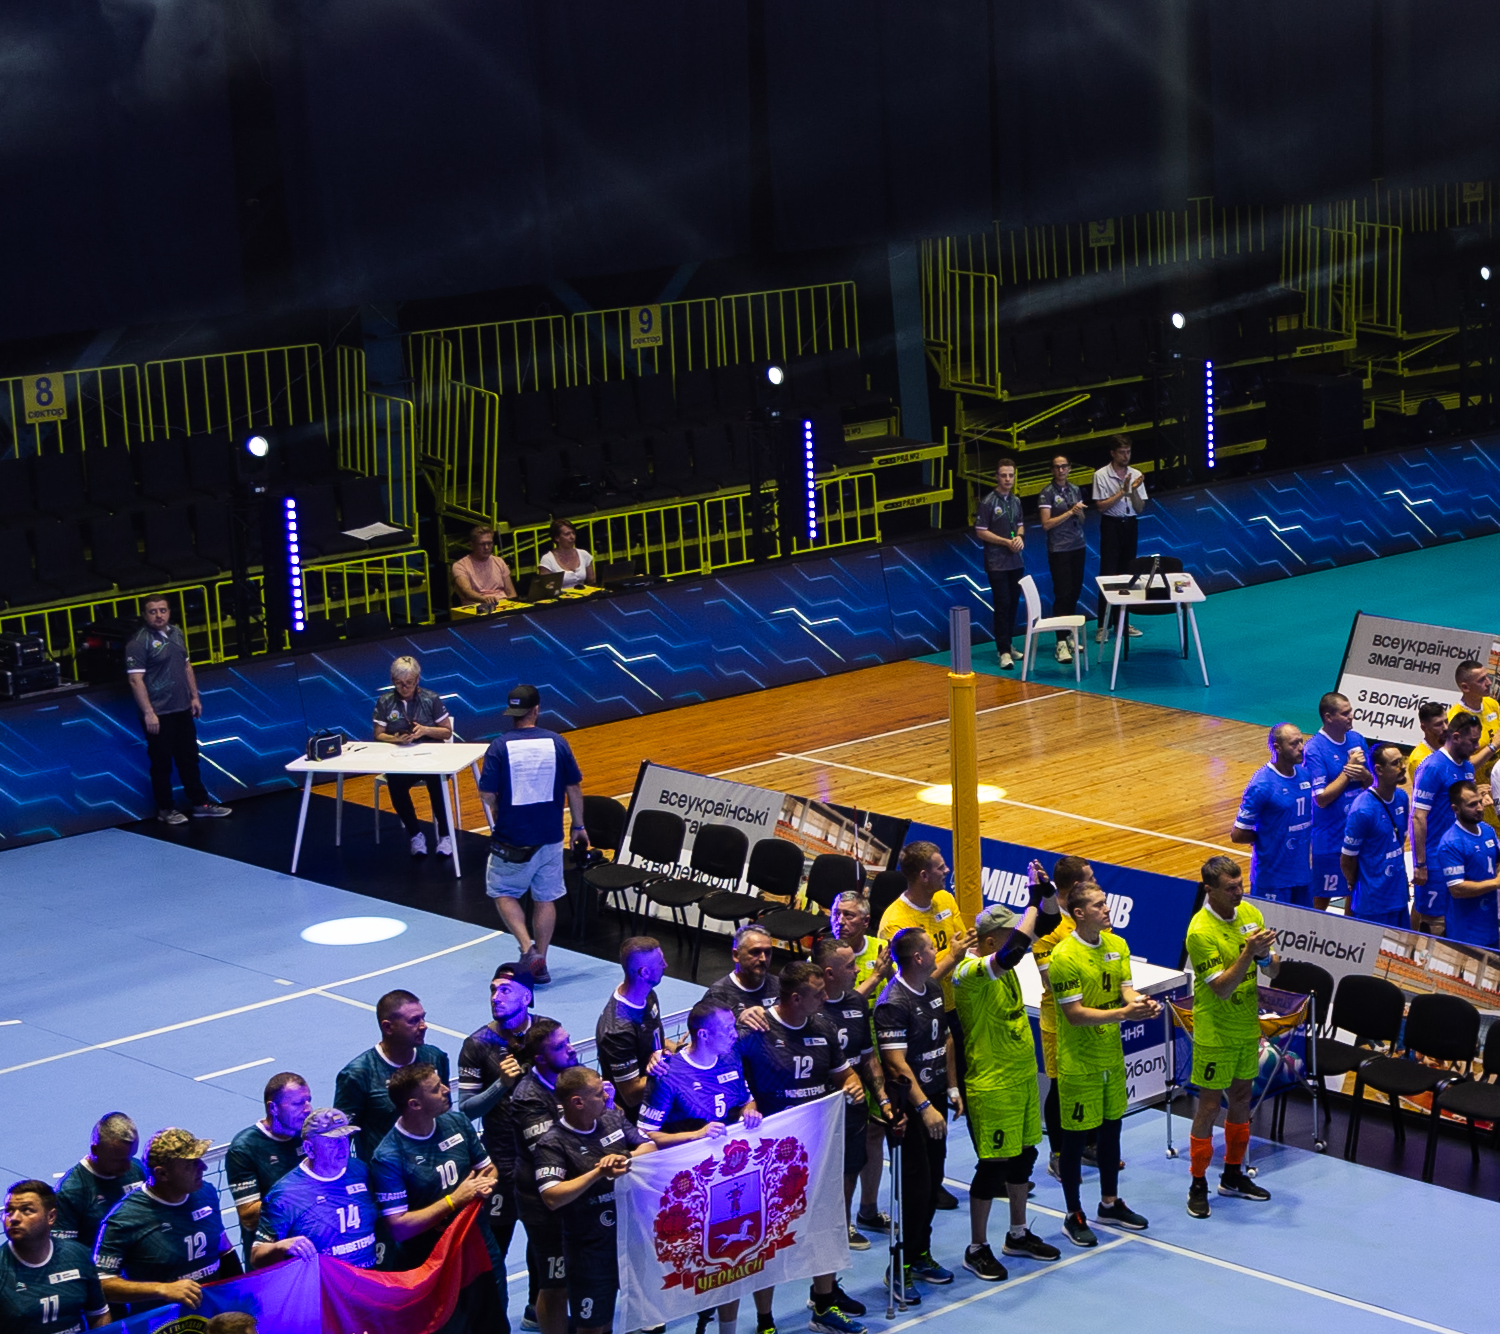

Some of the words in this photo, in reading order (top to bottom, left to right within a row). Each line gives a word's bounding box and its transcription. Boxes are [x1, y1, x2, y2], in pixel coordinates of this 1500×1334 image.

[637, 307, 653, 334] 9
[35, 377, 54, 406] 8
[27, 408, 65, 420] сектор
[1372, 634, 1481, 662] всеукраїнські
[1367, 653, 1441, 675] змагання
[1358, 690, 1367, 702] з
[1353, 708, 1415, 730] сидячи
[658, 789, 770, 827] всеукраїнські
[1296, 797, 1306, 817] 11
[1324, 874, 1338, 892] 12
[1427, 890, 1438, 908] 7
[933, 931, 947, 952] 12
[1101, 971, 1111, 993] 4
[931, 1018, 939, 1040] 8
[792, 1055, 813, 1079] 12
[1203, 1062, 1216, 1081] 6
[713, 1093, 727, 1118] 5
[1071, 1101, 1084, 1123] 4
[991, 1129, 1005, 1150] 9
[436, 1160, 459, 1189] 10
[490, 1194, 504, 1216] 2
[336, 1204, 362, 1234] 14
[183, 1231, 207, 1262] 12
[547, 1256, 566, 1279] 13
[697, 1257, 764, 1291] ЧЕРКАСИ
[39, 1295, 60, 1324] 11
[580, 1297, 594, 1319] 3
